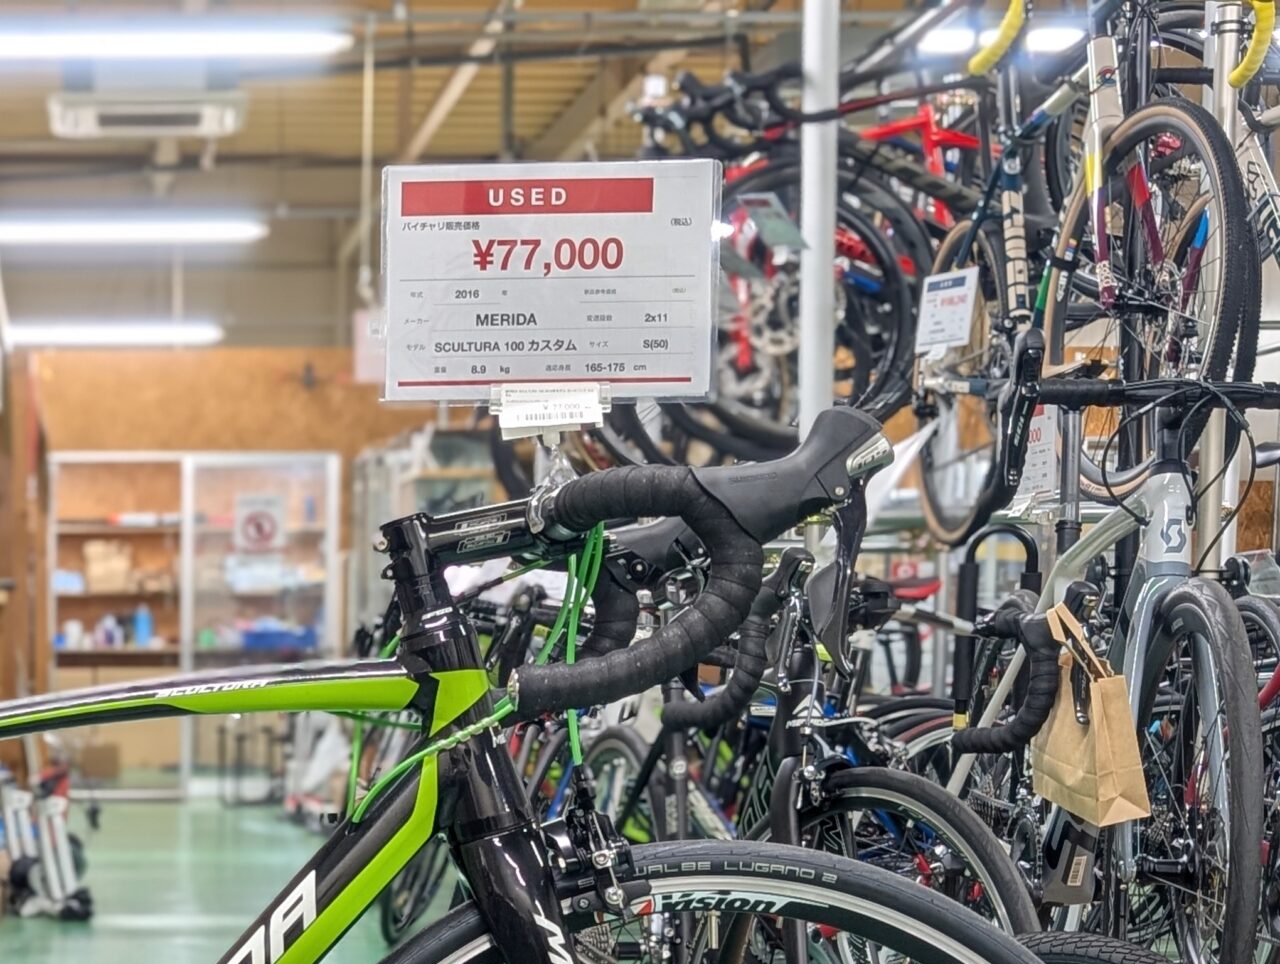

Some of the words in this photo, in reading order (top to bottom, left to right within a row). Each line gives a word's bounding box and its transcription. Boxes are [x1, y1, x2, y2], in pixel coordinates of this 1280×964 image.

[488, 187, 567, 206] USED
[401, 221, 480, 231] バイチャリ販売価格
[472, 237, 624, 277] ¥77,000
[455, 289, 480, 299] 2016
[476, 313, 537, 326] MERIDA
[644, 313, 668, 322] 2x11
[434, 342, 501, 353] SCULTURA
[505, 341, 525, 351] 100
[528, 339, 577, 352] カスタム
[643, 339, 669, 350] S(50)
[471, 365, 487, 374] 8.9
[499, 365, 511, 375] kg
[584, 363, 625, 373] 165-175
[633, 861, 711, 877] WALBE
[724, 861, 816, 879] LUGANO
[821, 873, 837, 884] 2
[661, 892, 779, 912] Vision
